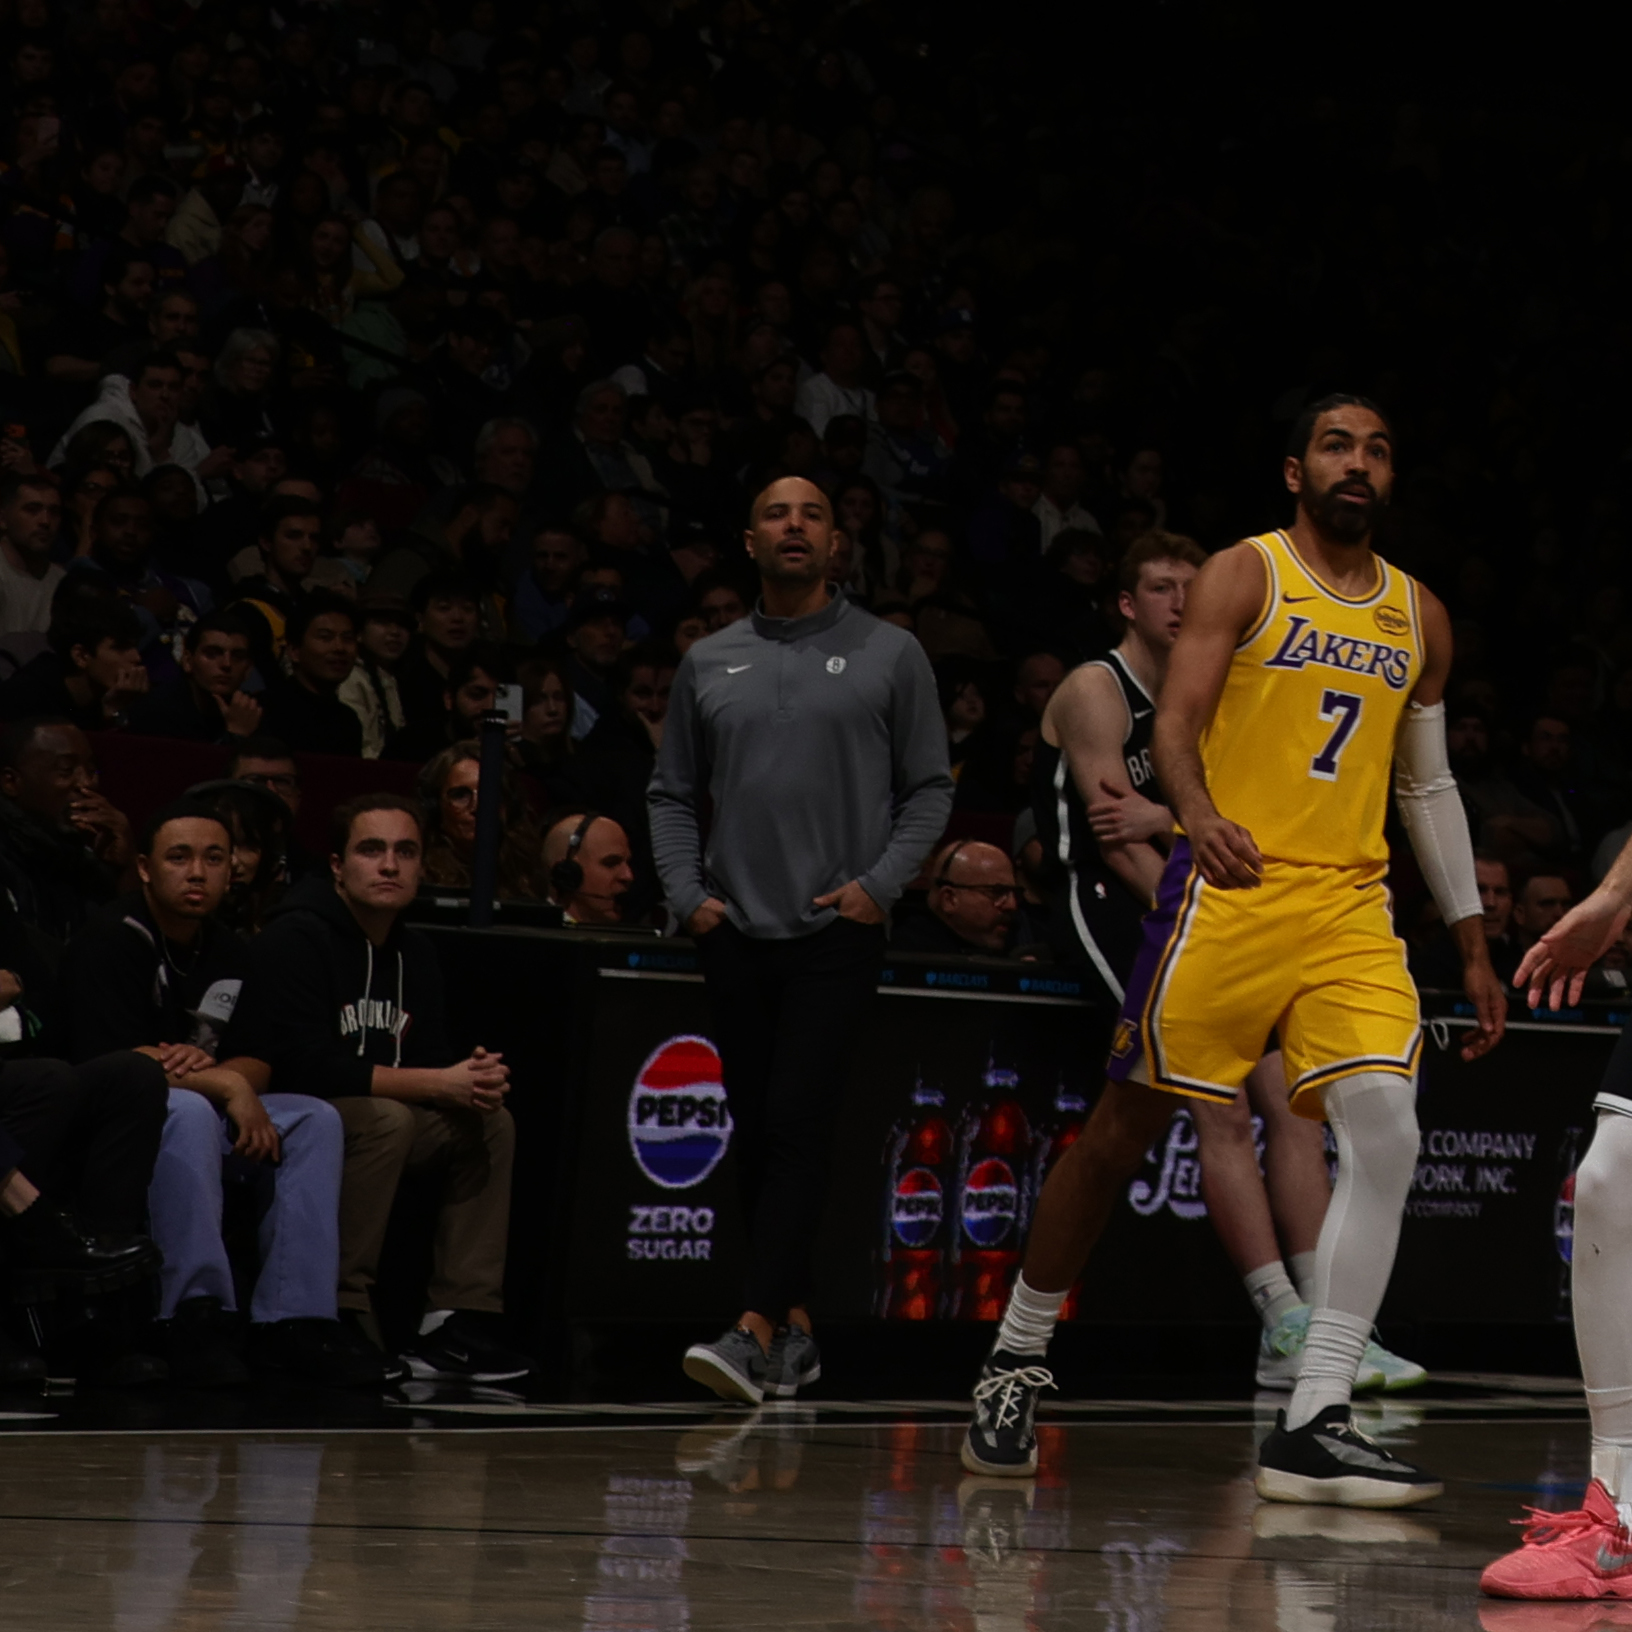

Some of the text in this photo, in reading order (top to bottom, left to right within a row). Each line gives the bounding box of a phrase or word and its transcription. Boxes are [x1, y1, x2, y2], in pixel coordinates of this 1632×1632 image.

[1262, 613, 1412, 692] LAKERS
[1307, 687, 1365, 782] 7
[637, 1094, 727, 1127] PEPSI
[1430, 1129, 1538, 1160] COMPANY
[1475, 1166, 1517, 1195] INC.
[628, 1205, 716, 1235] ZERO
[626, 1238, 714, 1262] SUGAR
